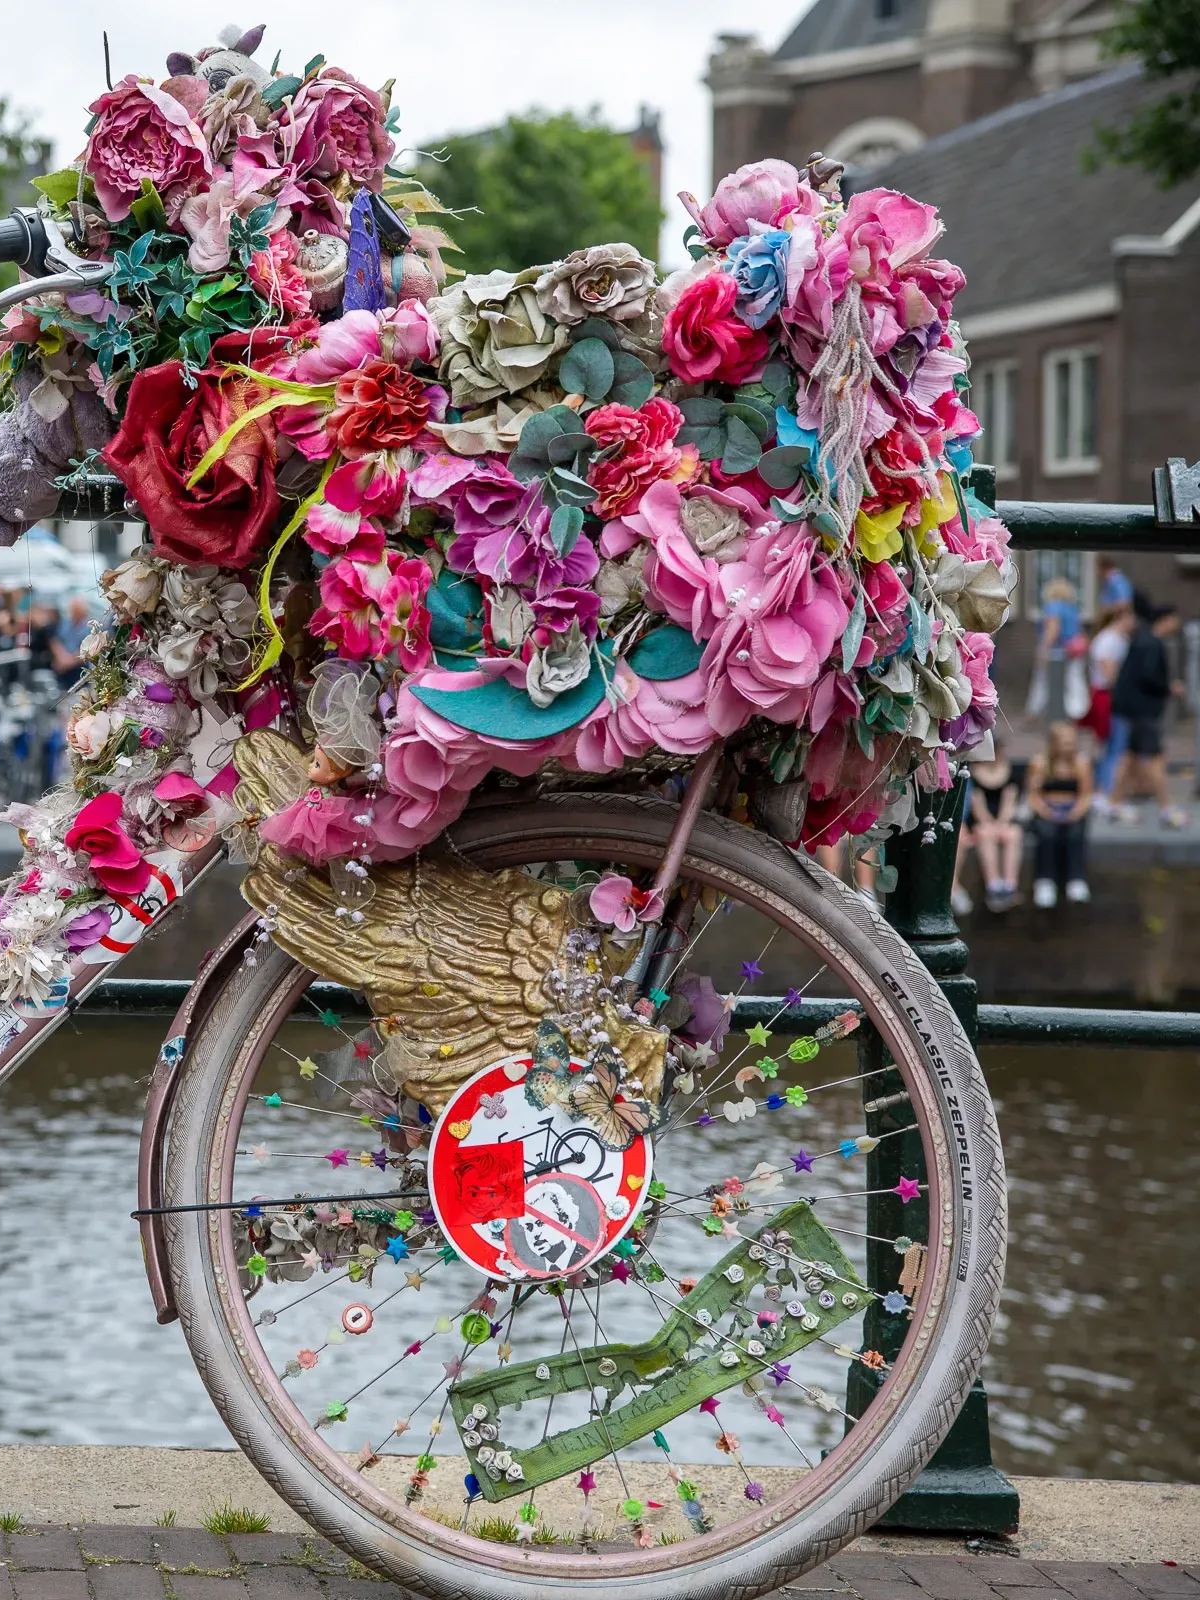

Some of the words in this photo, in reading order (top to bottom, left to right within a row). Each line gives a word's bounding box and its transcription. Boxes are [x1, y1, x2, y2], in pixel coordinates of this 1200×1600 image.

[880, 971, 909, 1001] CST
[906, 1006, 954, 1090] CLASSIC
[946, 1095, 973, 1201] ZEPPELIN
